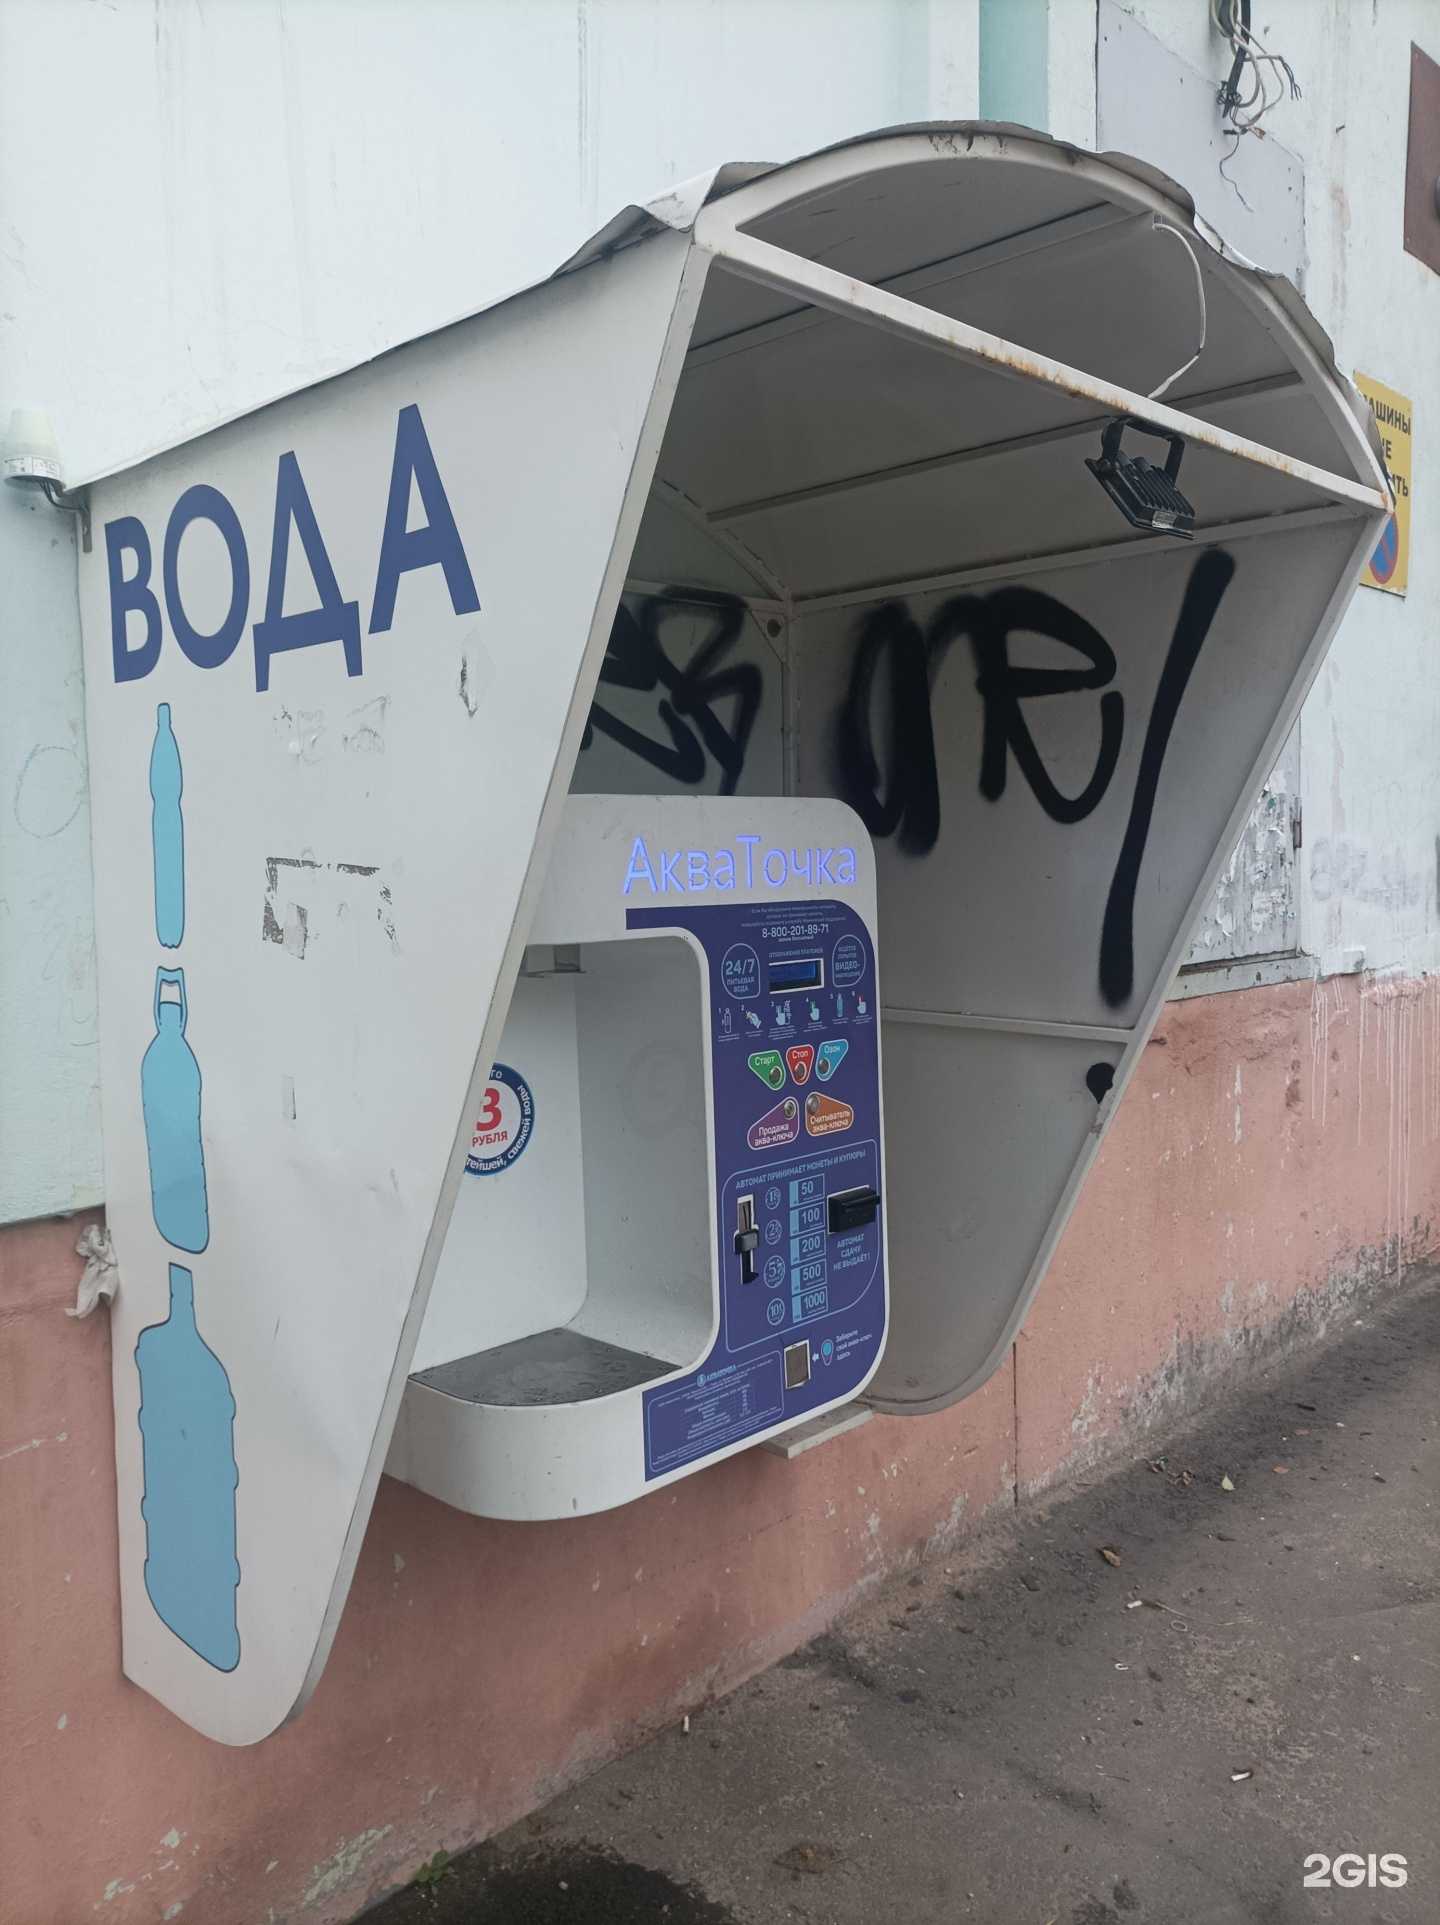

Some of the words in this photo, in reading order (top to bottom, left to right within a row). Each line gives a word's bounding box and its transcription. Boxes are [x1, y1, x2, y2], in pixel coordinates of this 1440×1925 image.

[1363, 393, 1411, 436] АШИНЫ
[104, 403, 481, 692] ВОДА
[624, 834, 857, 894] АкваТочка
[762, 923, 829, 938] 8-800-201-89-71
[725, 958, 755, 976] 24/7
[755, 1056, 775, 1067] Старт
[792, 1050, 808, 1059] Стоп
[476, 1087, 502, 1131] 3
[472, 1131, 508, 1147] РУБЛЯ
[736, 1174, 767, 1189] АВТОМАТ
[802, 1181, 814, 1196] 50
[802, 1208, 820, 1224] 100
[802, 1236, 820, 1253] 200
[803, 1264, 821, 1281] 500
[804, 1291, 825, 1309] 1000
